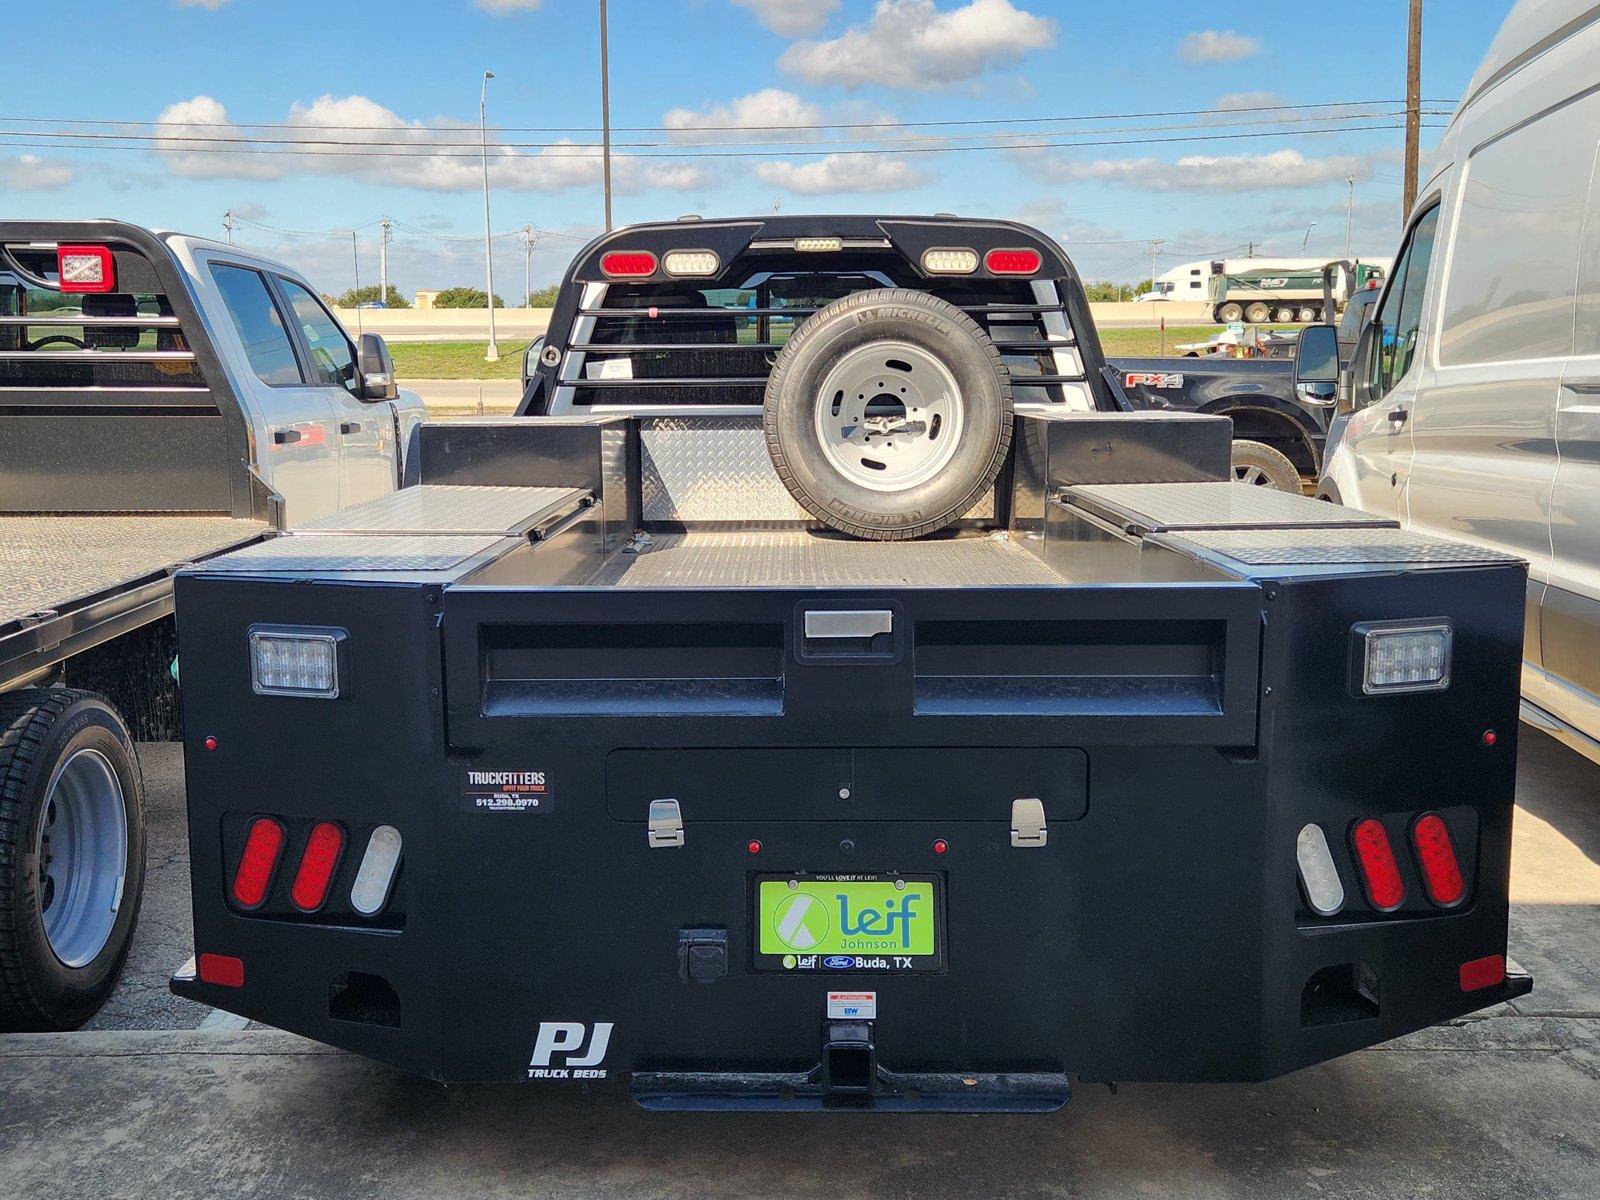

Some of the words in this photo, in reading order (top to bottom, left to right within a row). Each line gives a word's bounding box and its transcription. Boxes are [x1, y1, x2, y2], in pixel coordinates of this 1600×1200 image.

[877, 308, 952, 335] MICHELIN
[1126, 373, 1184, 389] FX4
[467, 771, 546, 785] TRUCKFITTERS
[840, 939, 897, 950] Johnson
[855, 957, 890, 969] Buda,
[894, 957, 912, 969] TX
[529, 1022, 615, 1067] PJ
[527, 1069, 569, 1079] TRUCK
[572, 1069, 607, 1079] BEDS
